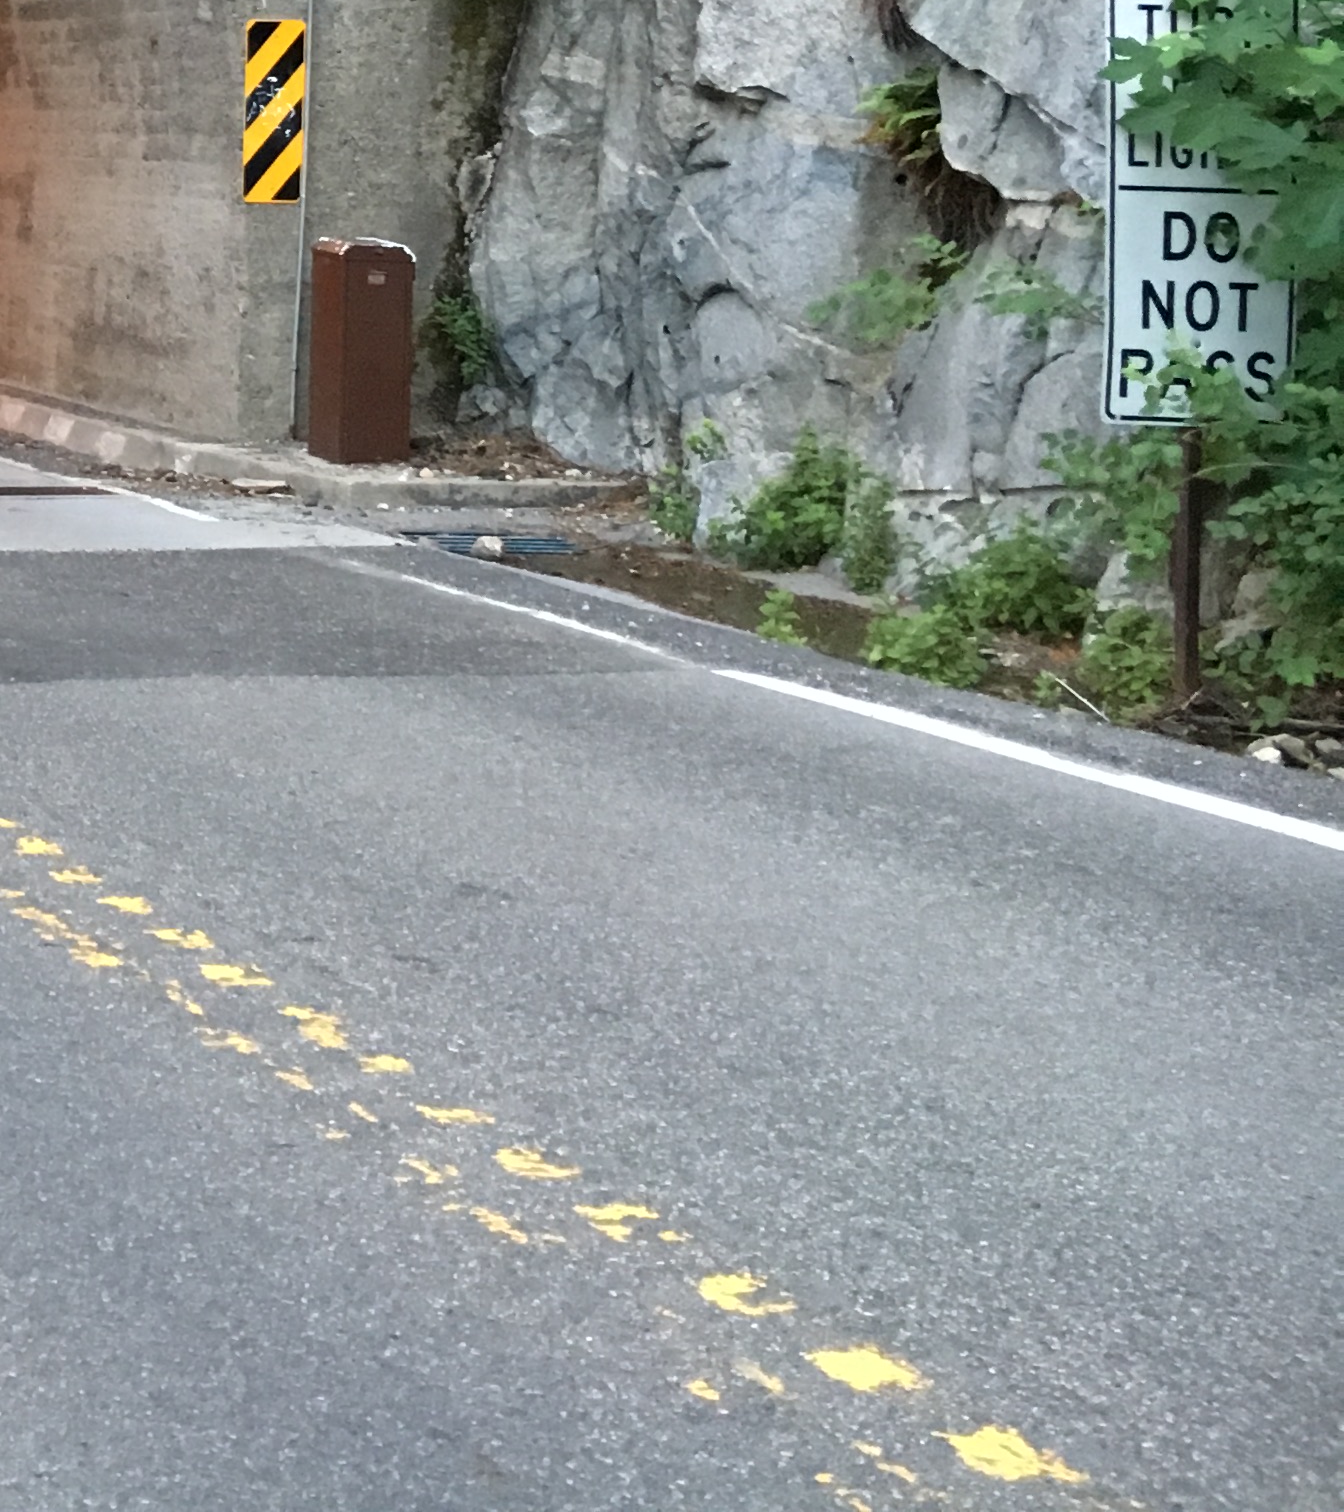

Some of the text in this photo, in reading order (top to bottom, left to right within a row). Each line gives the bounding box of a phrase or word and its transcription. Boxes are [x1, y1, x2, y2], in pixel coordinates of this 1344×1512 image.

[1128, 128, 1237, 170] LIG
[1163, 211, 1240, 263] DO
[1141, 279, 1259, 332] NOT
